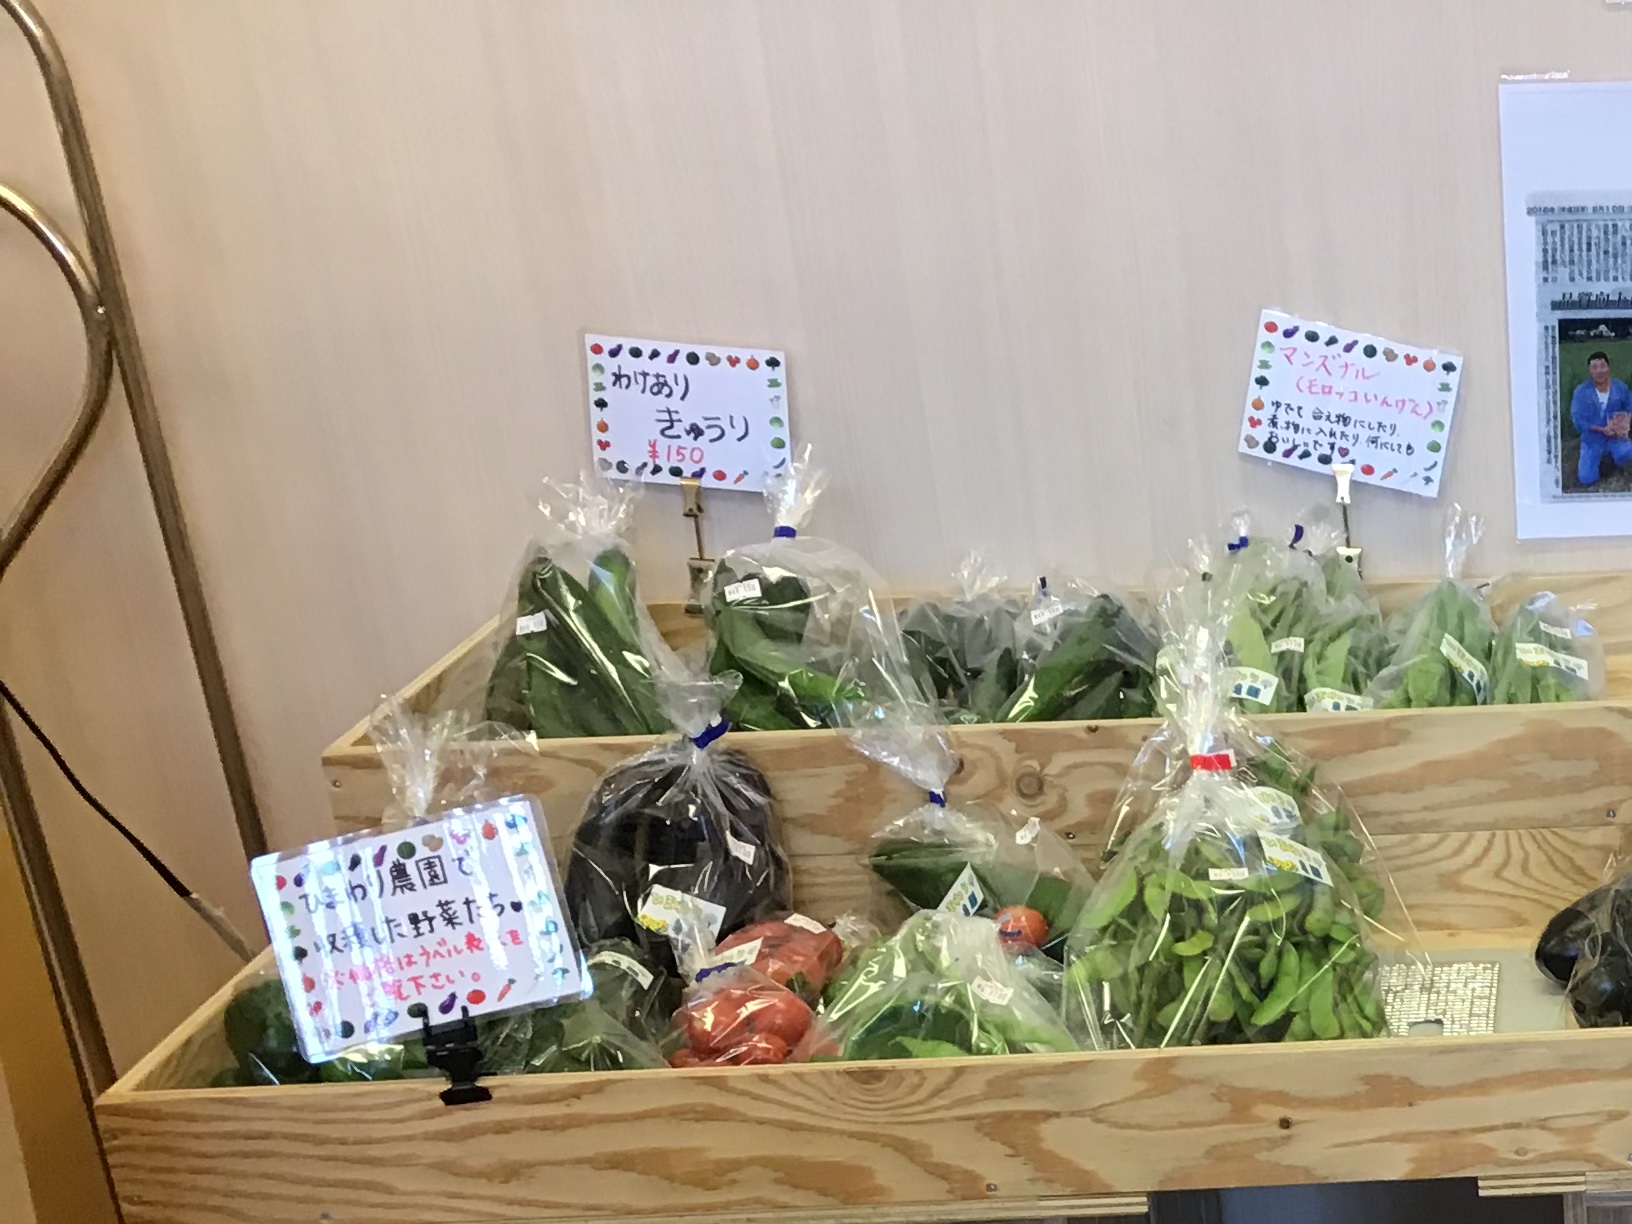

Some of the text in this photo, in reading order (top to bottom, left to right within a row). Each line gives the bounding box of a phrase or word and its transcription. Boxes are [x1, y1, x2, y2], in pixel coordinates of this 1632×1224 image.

[611, 365, 690, 401] わけあり
[655, 407, 749, 443] きゅうり
[648, 439, 704, 464] ¥150
